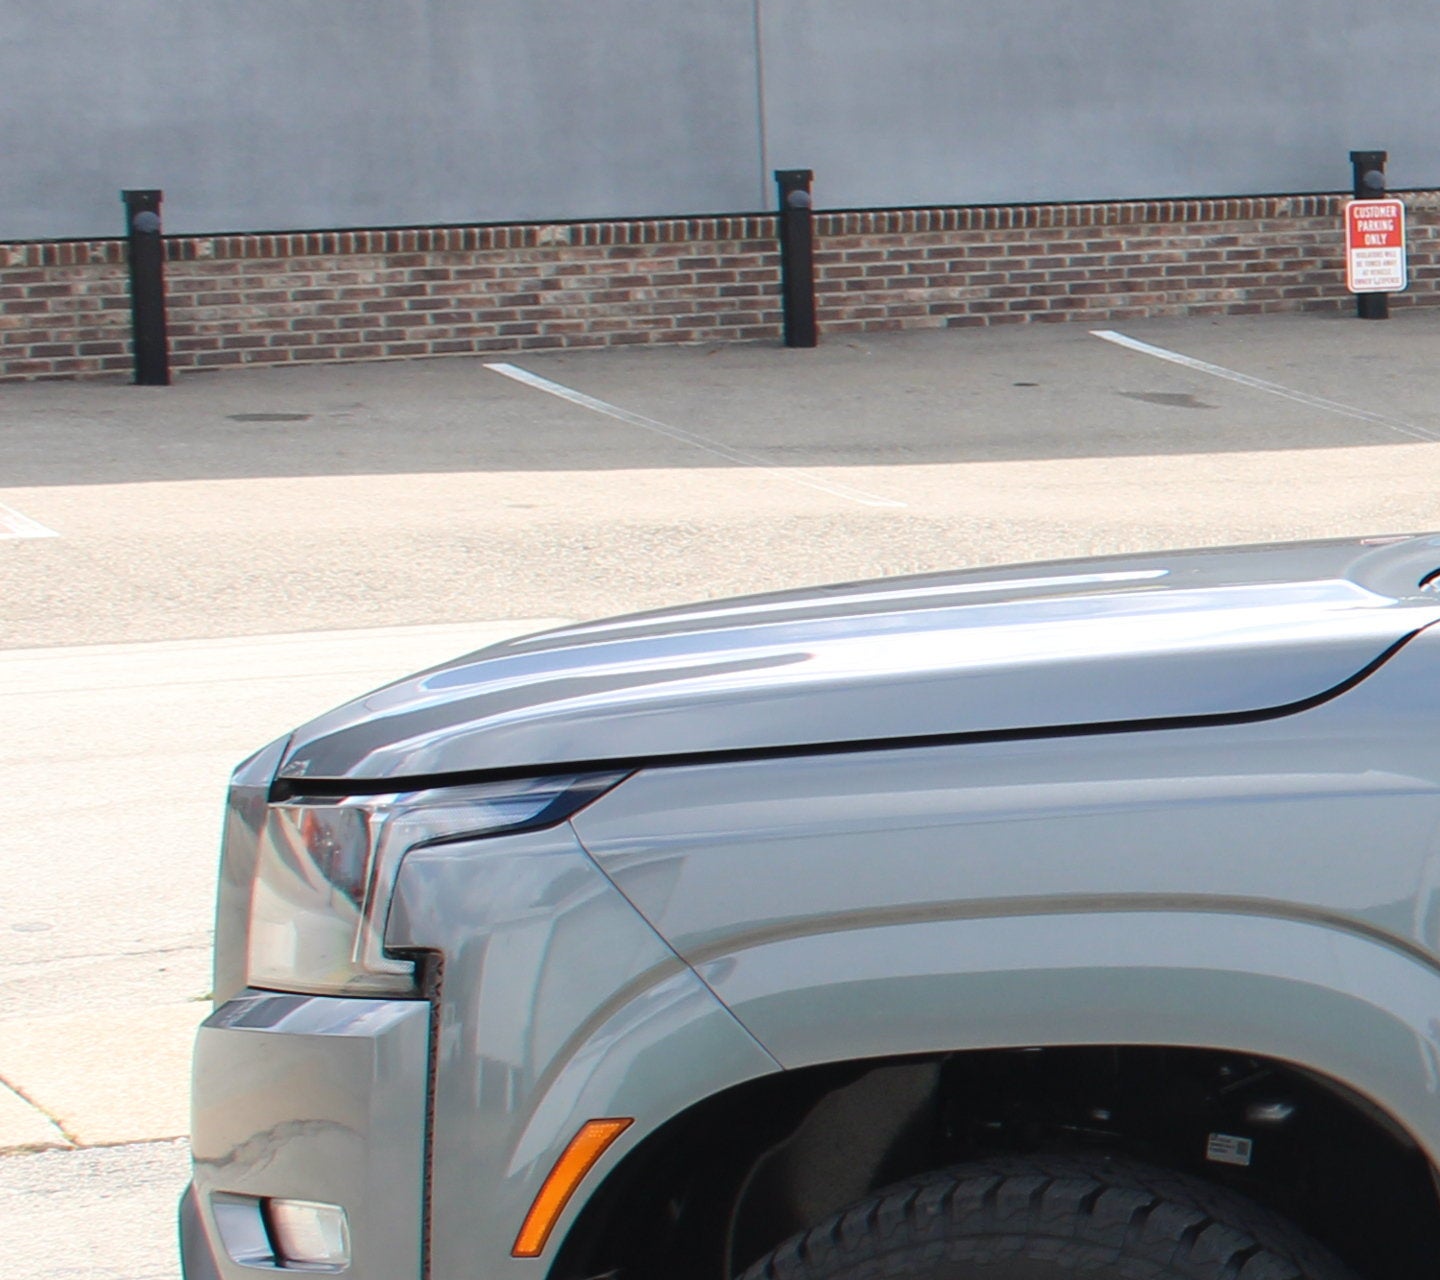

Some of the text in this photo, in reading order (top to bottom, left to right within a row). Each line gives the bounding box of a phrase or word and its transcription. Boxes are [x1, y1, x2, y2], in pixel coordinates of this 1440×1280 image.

[1353, 206, 1397, 219] CUSTOMER
[1357, 220, 1394, 232] PARKING
[1364, 233, 1388, 245] ONLY
